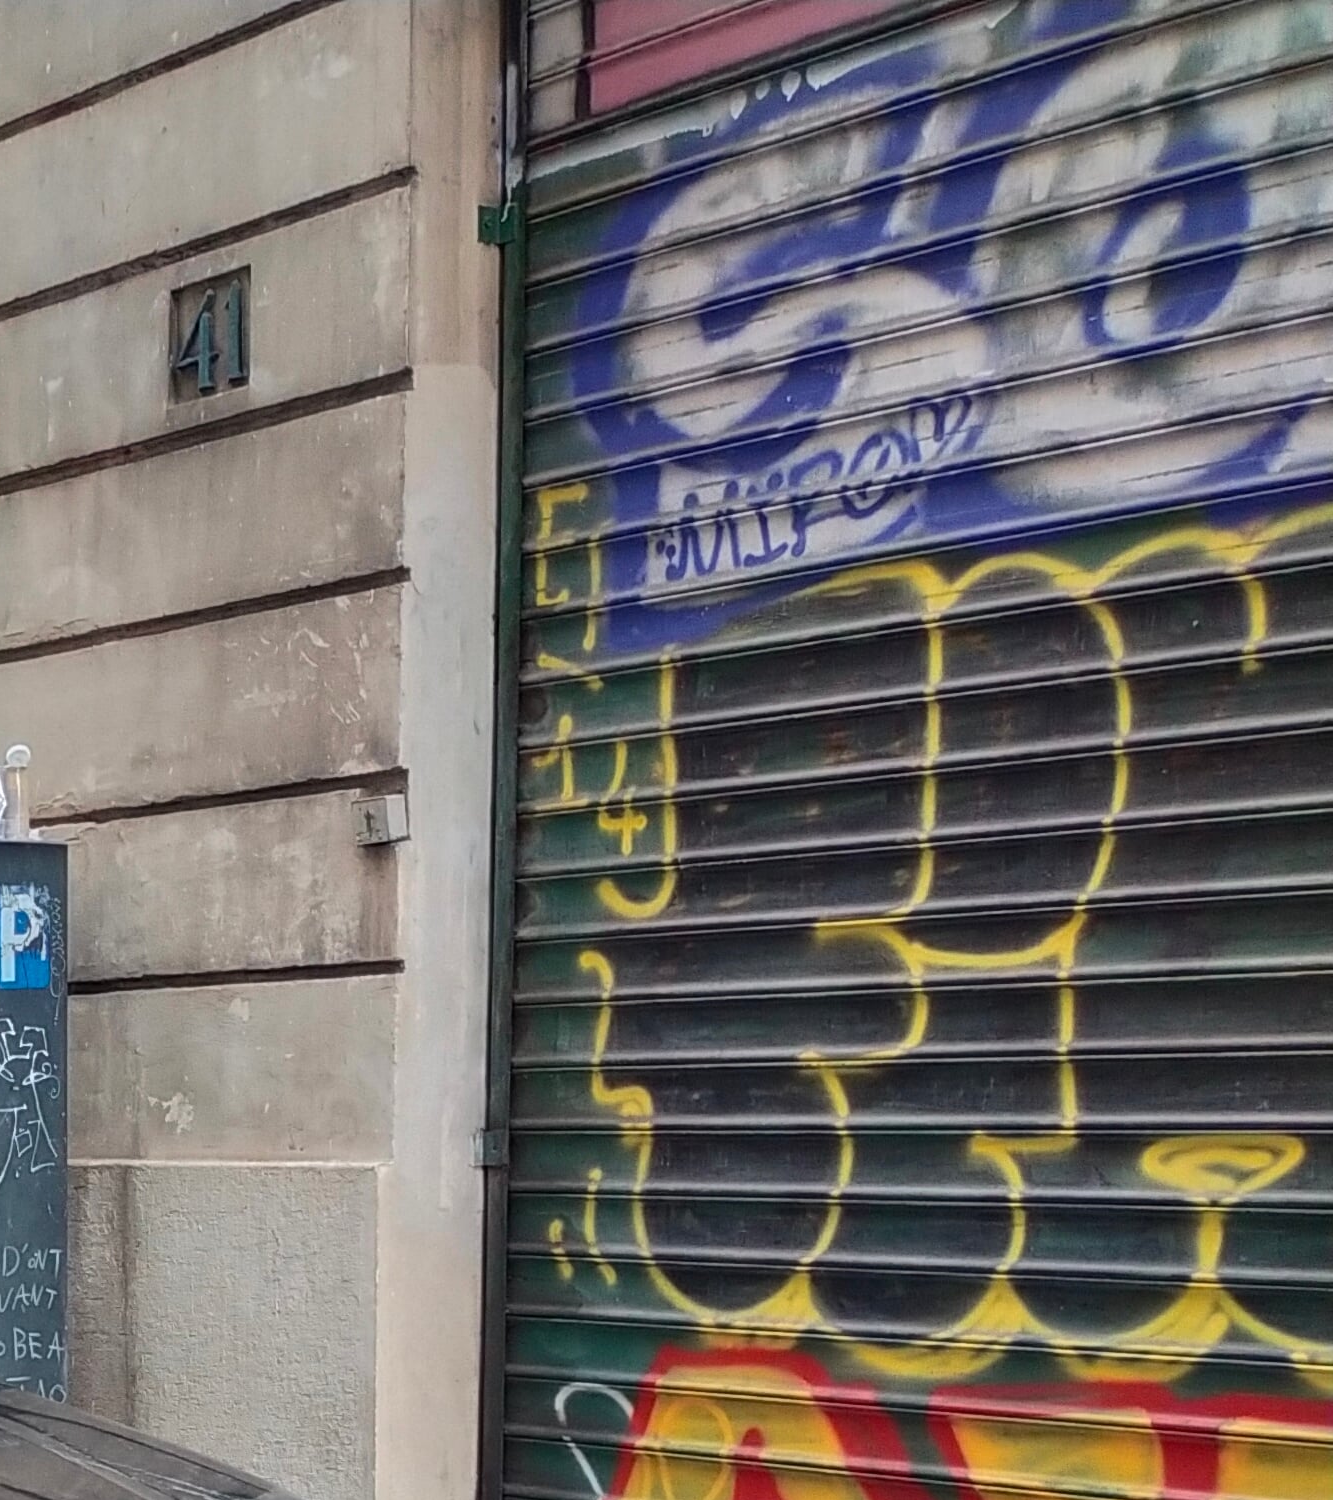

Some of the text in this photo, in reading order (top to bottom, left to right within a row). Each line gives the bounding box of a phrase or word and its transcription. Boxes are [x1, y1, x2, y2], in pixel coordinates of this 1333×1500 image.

[175, 277, 247, 395] 41
[0, 893, 42, 983] P
[13, 1326, 43, 1361] BE
[46, 1331, 65, 1363] A
